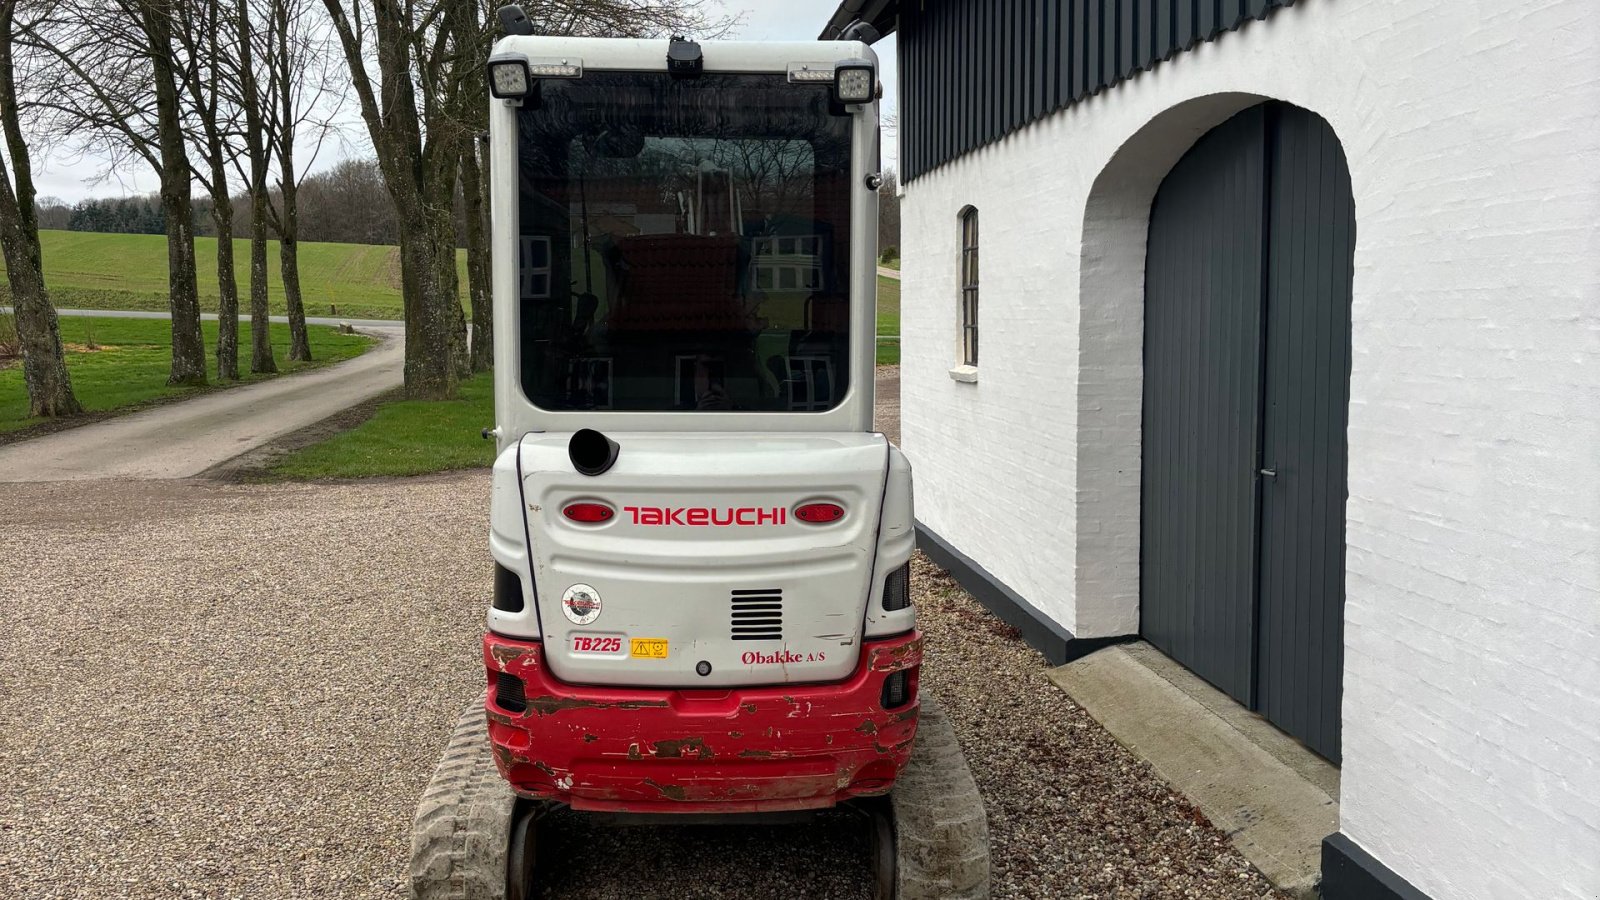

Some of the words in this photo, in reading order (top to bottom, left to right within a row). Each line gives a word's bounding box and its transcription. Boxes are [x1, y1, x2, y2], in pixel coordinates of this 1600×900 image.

[574, 637, 621, 652] TB225
[741, 650, 803, 665] Øbakke
[806, 651, 825, 662] A/S
